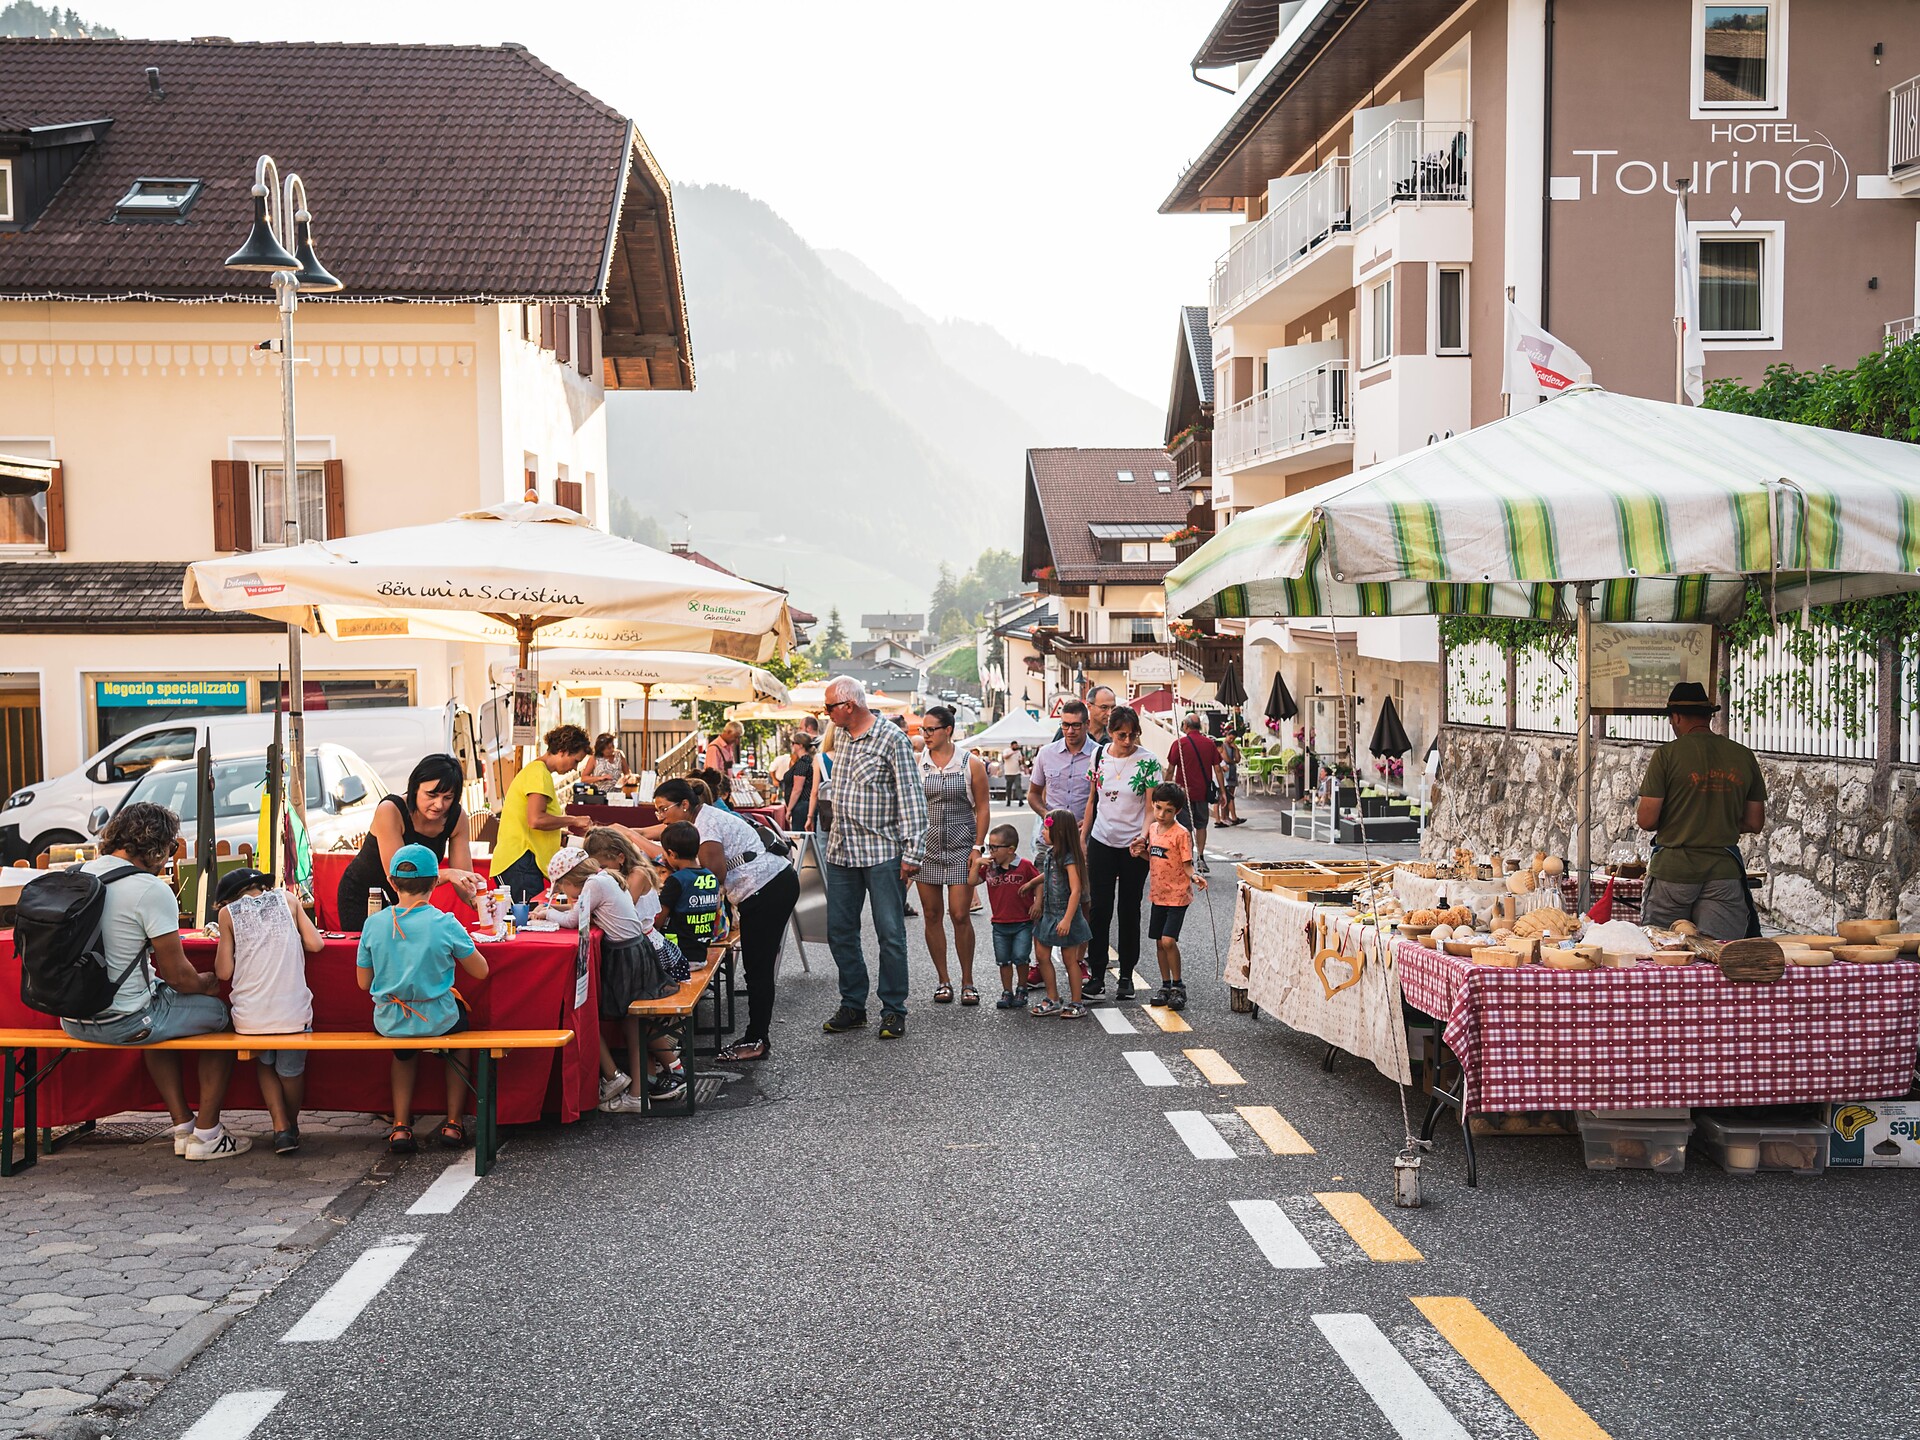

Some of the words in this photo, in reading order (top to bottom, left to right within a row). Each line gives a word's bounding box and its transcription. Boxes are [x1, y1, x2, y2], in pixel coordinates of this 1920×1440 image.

[1711, 124, 1810, 143] HOTEL
[1572, 150, 1824, 204] Touring
[1535, 370, 1565, 387] Gardena
[377, 581, 416, 596] Bën
[420, 580, 455, 597] unì
[459, 587, 475, 598] a
[478, 585, 585, 605] S.Cristina
[702, 604, 747, 616] Raiffeisen
[104, 682, 154, 697] Negozio
[157, 682, 240, 697] specializzato
[147, 698, 181, 706] specialized
[693, 874, 717, 890] 46
[211, 1135, 237, 1154] AX
[1831, 1157, 1862, 1165] Bananas
